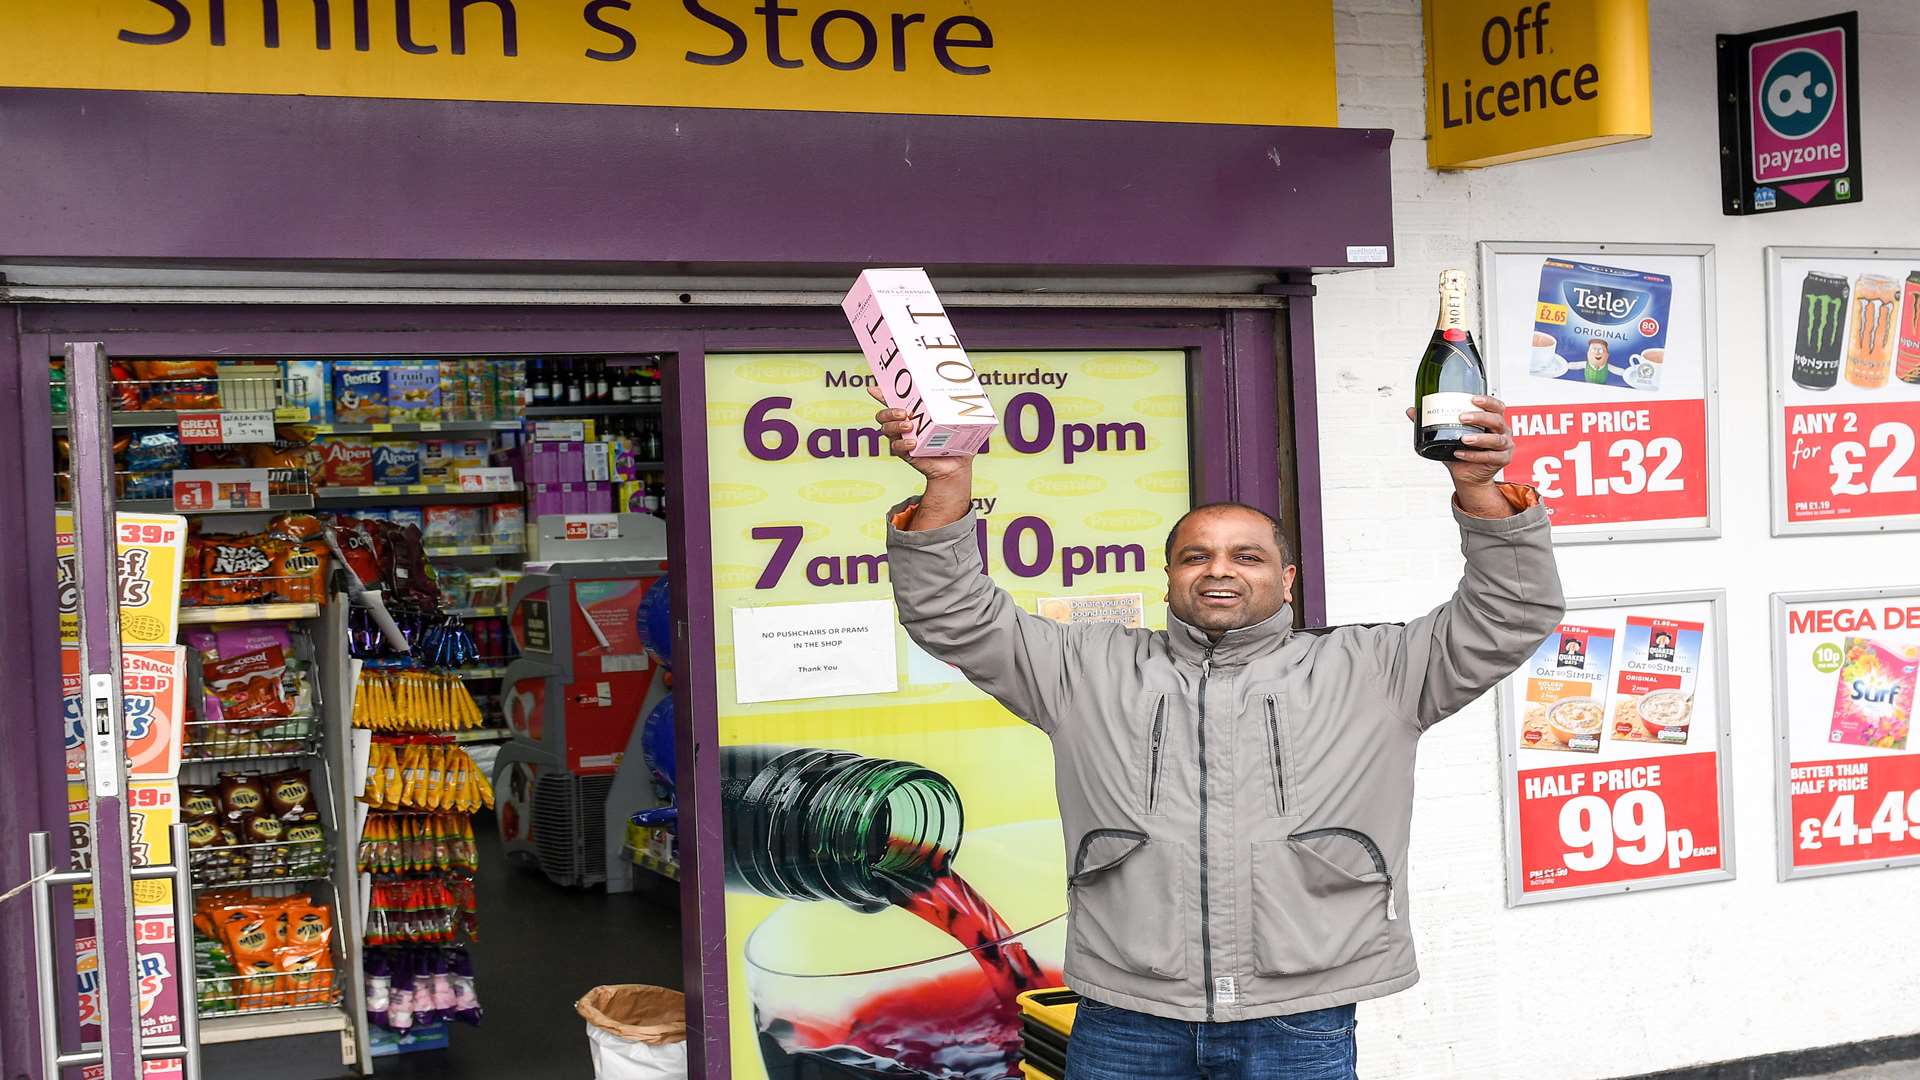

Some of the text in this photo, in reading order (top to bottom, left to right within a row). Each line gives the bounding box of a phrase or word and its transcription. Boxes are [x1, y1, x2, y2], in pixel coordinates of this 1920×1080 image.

[685, 0, 995, 75] Store
[1482, 2, 1549, 65] Off
[1442, 63, 1599, 129] Licence
[1759, 143, 1842, 174] payzone
[1574, 288, 1638, 318] Tetley
[1540, 308, 1566, 322] £2.65
[1574, 326, 1628, 340] ORIGINAL
[1642, 322, 1655, 330] 80
[906, 305, 997, 418] MOËT
[825, 368, 1068, 389] Mon aturday
[181, 419, 219, 429] GREAT
[1512, 409, 1650, 436] HALF PRICE
[1791, 412, 1858, 436] ANY 2
[182, 428, 219, 438] DEALS!
[327, 445, 372, 462] Alpen
[377, 449, 416, 465] Alpen
[1791, 438, 1821, 470] for
[1829, 421, 1918, 497] £2
[1532, 436, 1684, 499] £1.32
[181, 488, 203, 505] £1
[121, 524, 175, 543] 39p
[1071, 610, 1098, 618] pound
[1109, 608, 1127, 616] help
[1789, 607, 1920, 634] MEGA DE
[776, 629, 827, 638] PUSHCHAIRS
[841, 626, 869, 634] PRAMS
[1559, 654, 1584, 662] QUAKER
[1650, 647, 1675, 655] QUAKER
[1817, 648, 1840, 663] 10p
[133, 659, 173, 675] SNACK
[798, 665, 820, 673] Thank
[1536, 667, 1556, 676] OAT
[1565, 670, 1602, 680] SIMPLE
[1627, 660, 1647, 670] OAT
[1656, 663, 1692, 673] SIMPLE
[1625, 674, 1658, 683] ORIGINAL
[1851, 680, 1901, 705] Surf
[1791, 763, 1868, 779] BETTER THAN
[1524, 765, 1661, 799] HALF PRICE
[1791, 776, 1868, 795] HALF PRICE
[279, 785, 306, 797] MINI
[289, 829, 320, 838] MINI
[1558, 790, 1717, 872] 99p EACH
[142, 1024, 173, 1036] ASTE!
